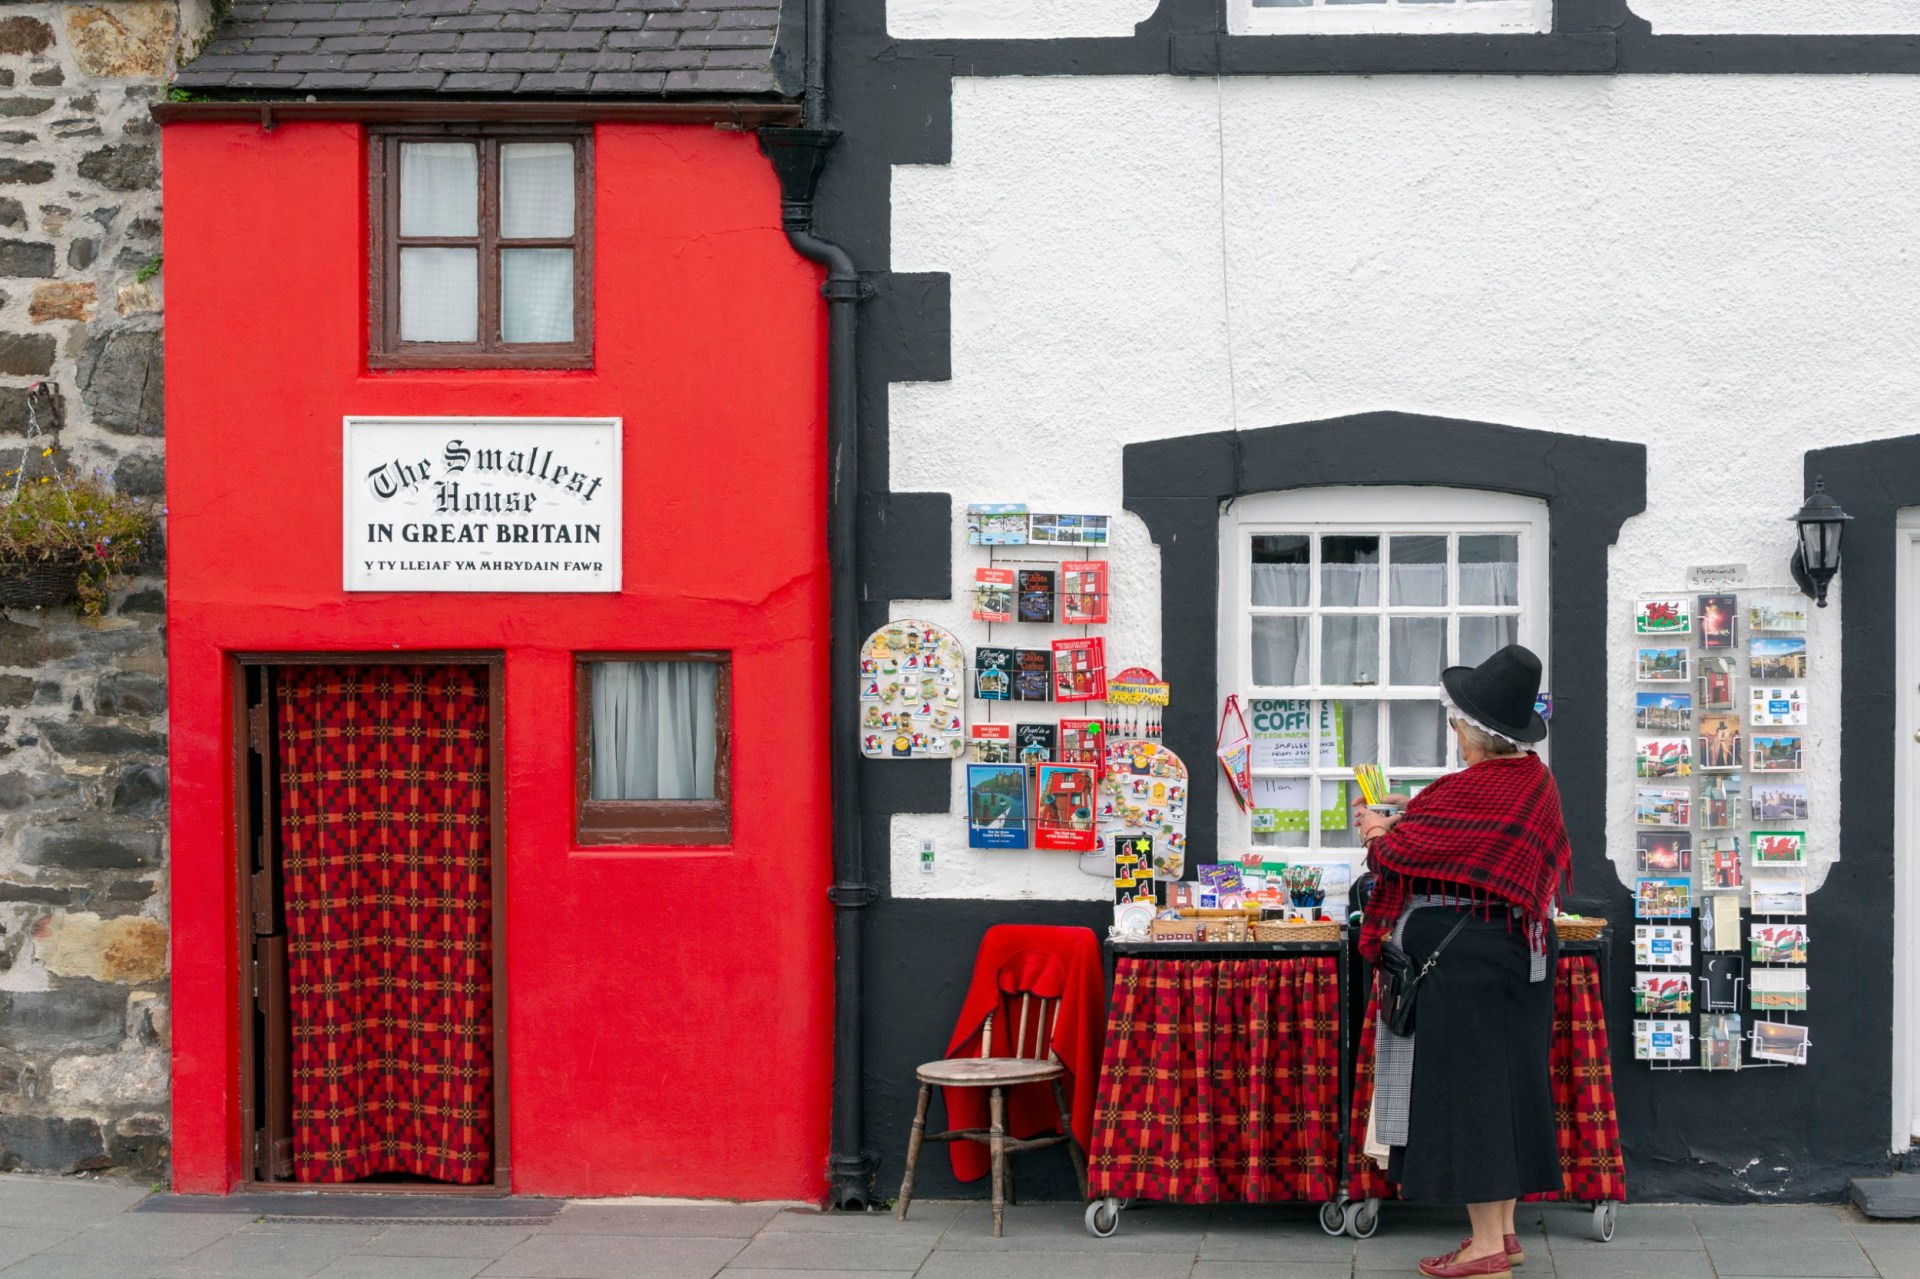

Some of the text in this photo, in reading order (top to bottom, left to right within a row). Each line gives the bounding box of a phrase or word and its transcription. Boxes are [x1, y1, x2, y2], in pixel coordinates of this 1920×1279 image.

[368, 439, 603, 501] The Smallest
[434, 481, 538, 513] House
[368, 523, 601, 544] IN GREAT BRITAIN
[364, 560, 604, 572] Y TY LLEIAF YM MHRYDAIN FAWR
[1253, 699, 1296, 712] COME
